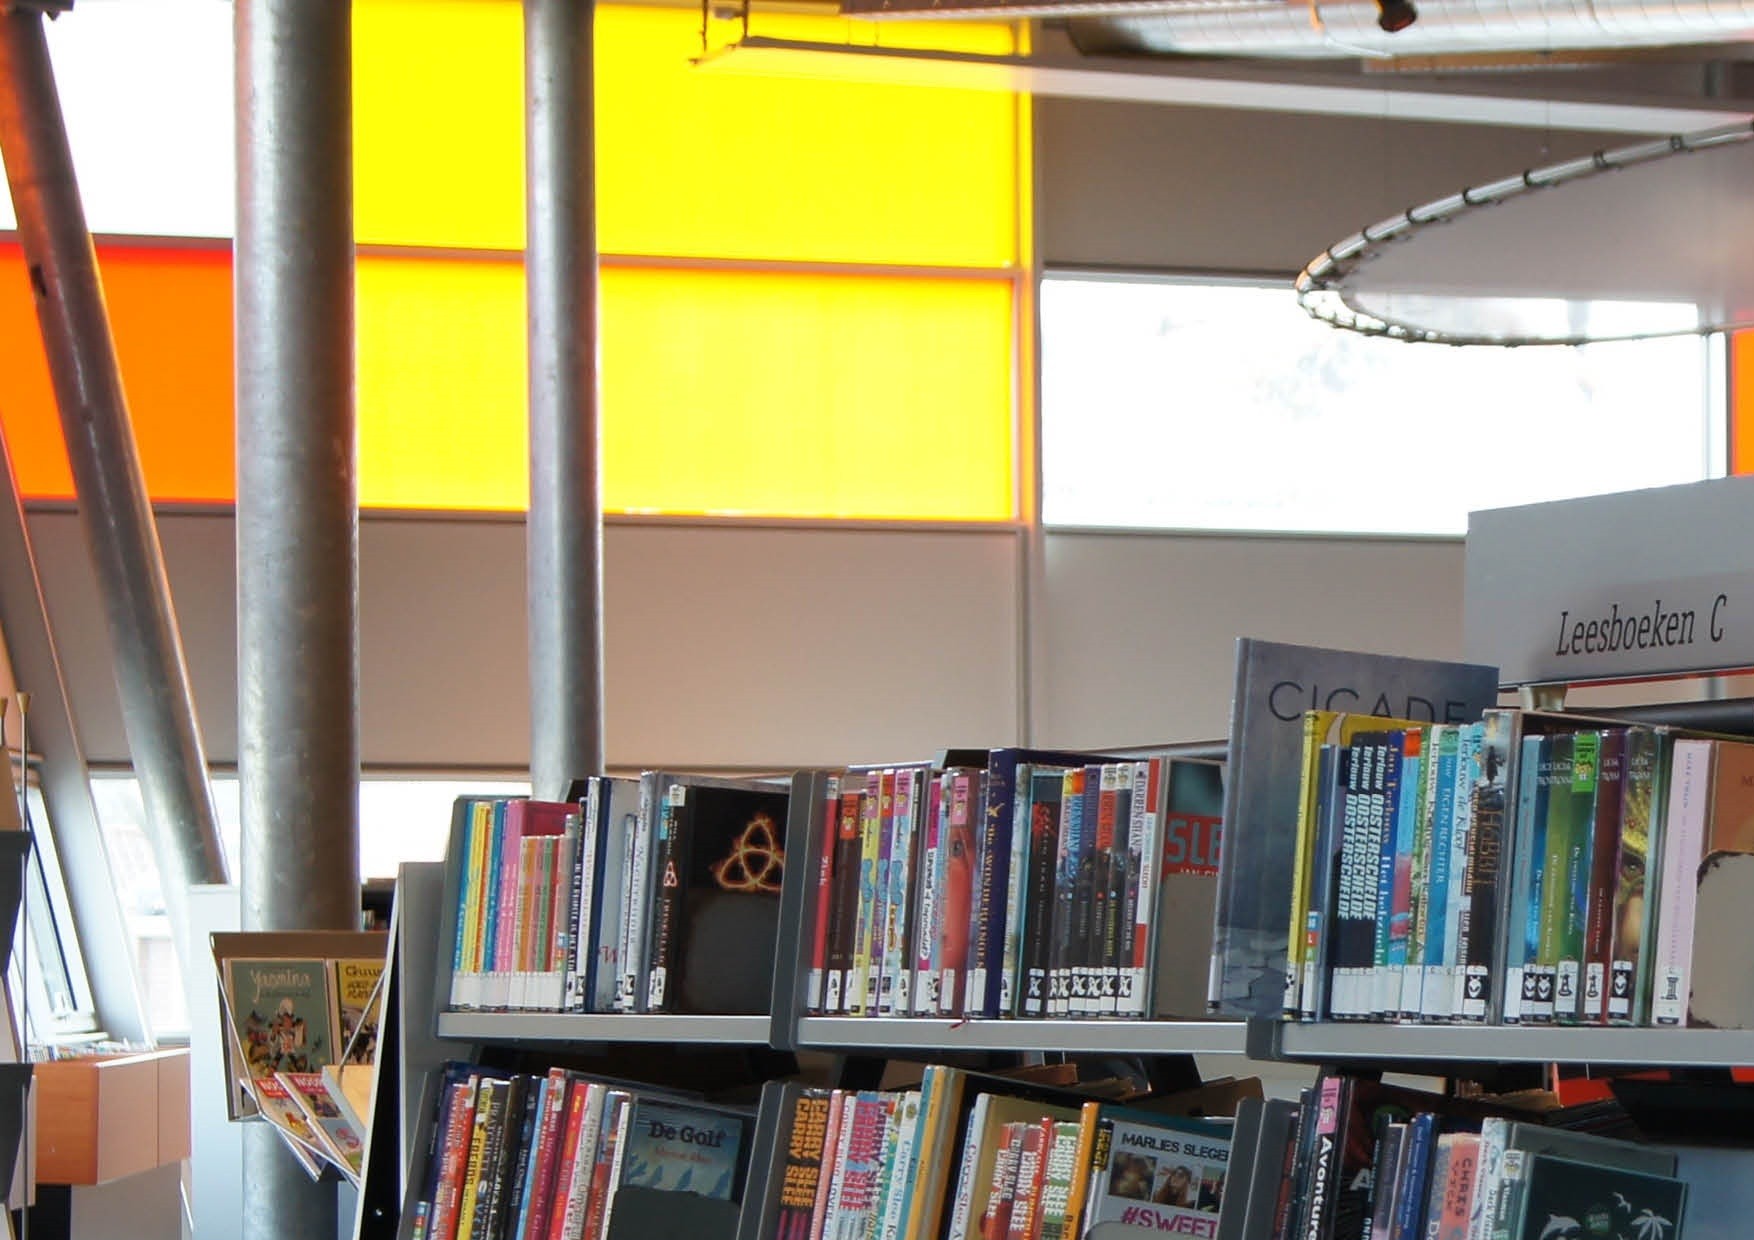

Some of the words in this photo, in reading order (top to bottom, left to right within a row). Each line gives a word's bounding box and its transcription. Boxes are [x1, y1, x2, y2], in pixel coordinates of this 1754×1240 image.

[1556, 600, 1696, 657] Leesboeken
[1709, 593, 1728, 643] C
[1349, 746, 1359, 790] Terlouw
[1361, 746, 1373, 789] Terlouw
[1375, 744, 1386, 789] Terlouw
[1388, 744, 1398, 773] Jan
[1458, 736, 1470, 790] Terlouw
[1131, 779, 1146, 817] DARREN
[1383, 780, 1395, 844] Terlouw
[1458, 796, 1465, 811] de
[1130, 819, 1143, 848] SHAN
[1454, 815, 1464, 849] Kloof
[1337, 793, 1357, 919] OOSTERSCHELDE
[1348, 793, 1370, 919] OOSTERSCHELDE
[1362, 793, 1383, 920] OOSTERSCHELDE
[1380, 855, 1389, 884] Het
[648, 1120, 677, 1140] De
[680, 1125, 727, 1148] Golf
[789, 1098, 811, 1159] CARRY
[1121, 1132, 1179, 1154] MARLIES
[1183, 1143, 1230, 1162] SLEGE
[894, 1139, 912, 1186] Carry
[889, 1188, 902, 1220] Slee
[1453, 1157, 1472, 1216] CHRIS
[1121, 1206, 1218, 1240] #SWEET
